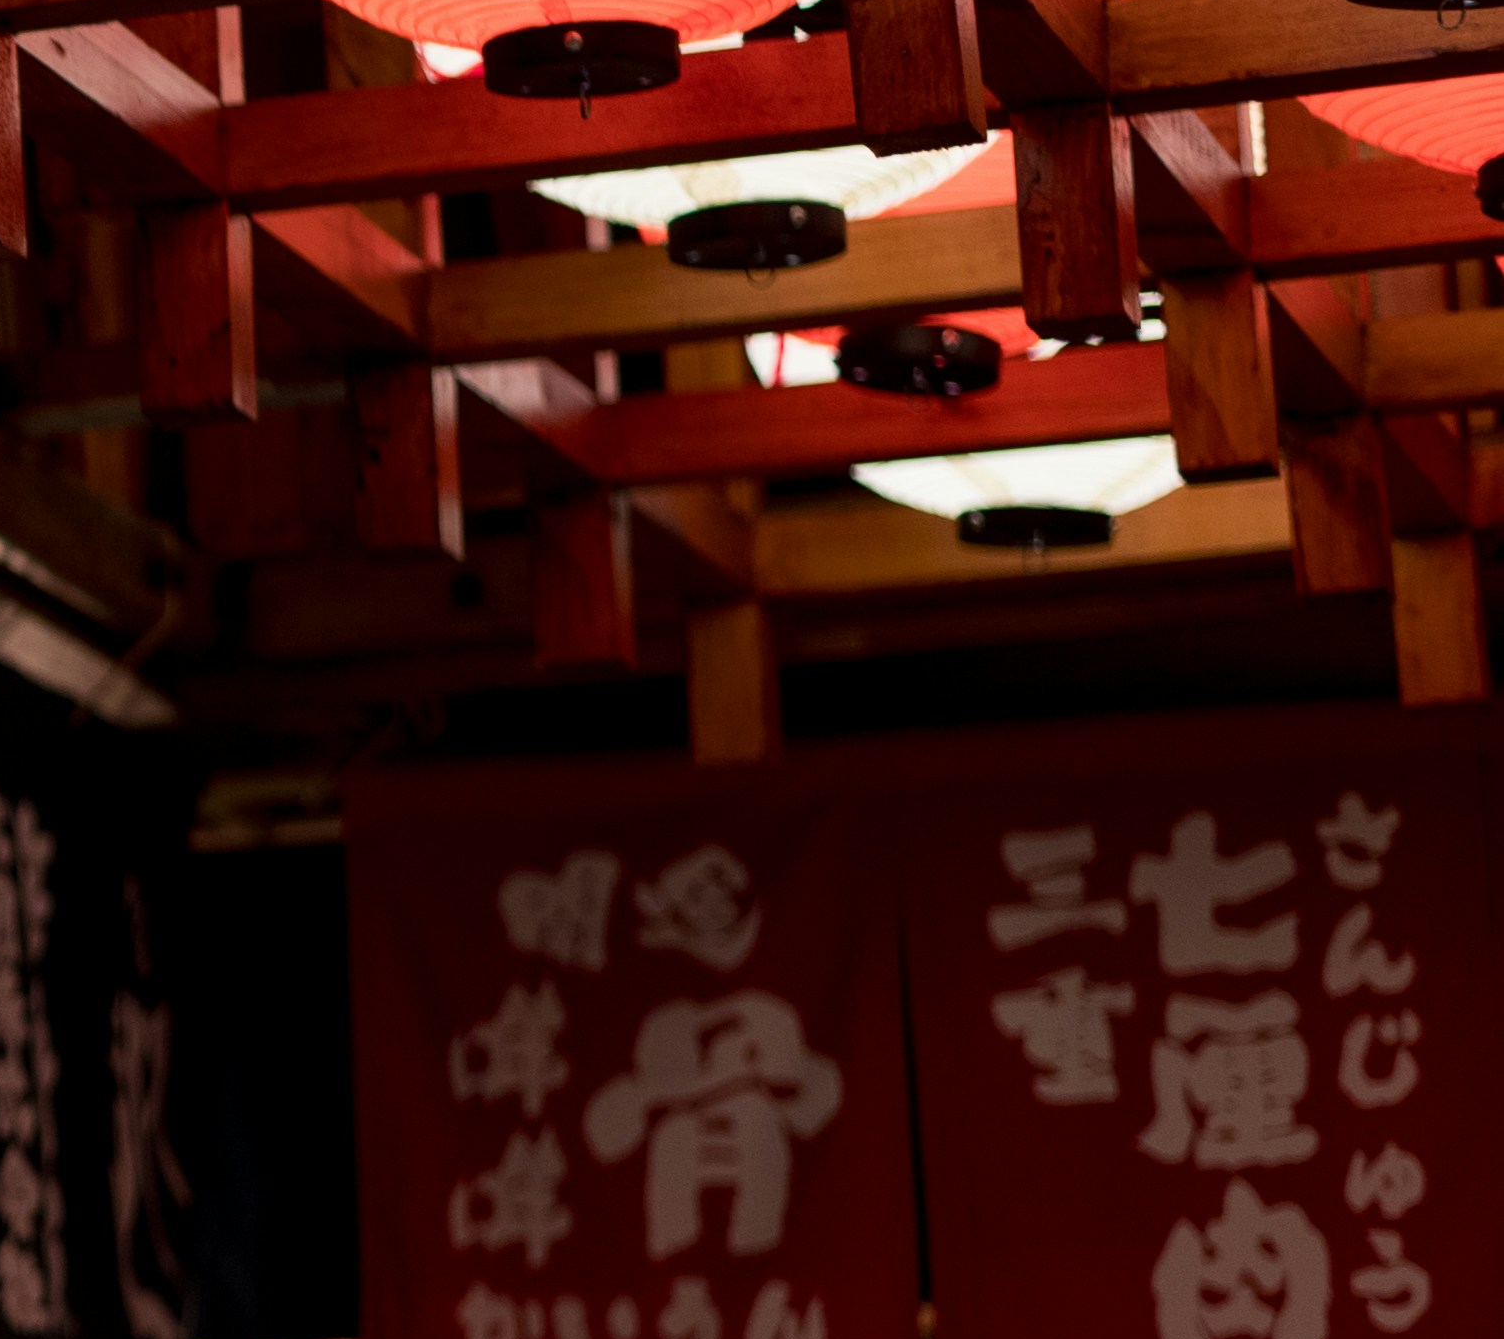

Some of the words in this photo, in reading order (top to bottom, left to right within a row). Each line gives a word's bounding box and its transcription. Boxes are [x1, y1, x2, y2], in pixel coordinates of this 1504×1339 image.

[986, 822, 1136, 1105] 三重
[1316, 790, 1433, 1335] さんじゅう
[584, 990, 843, 1260] 骨
